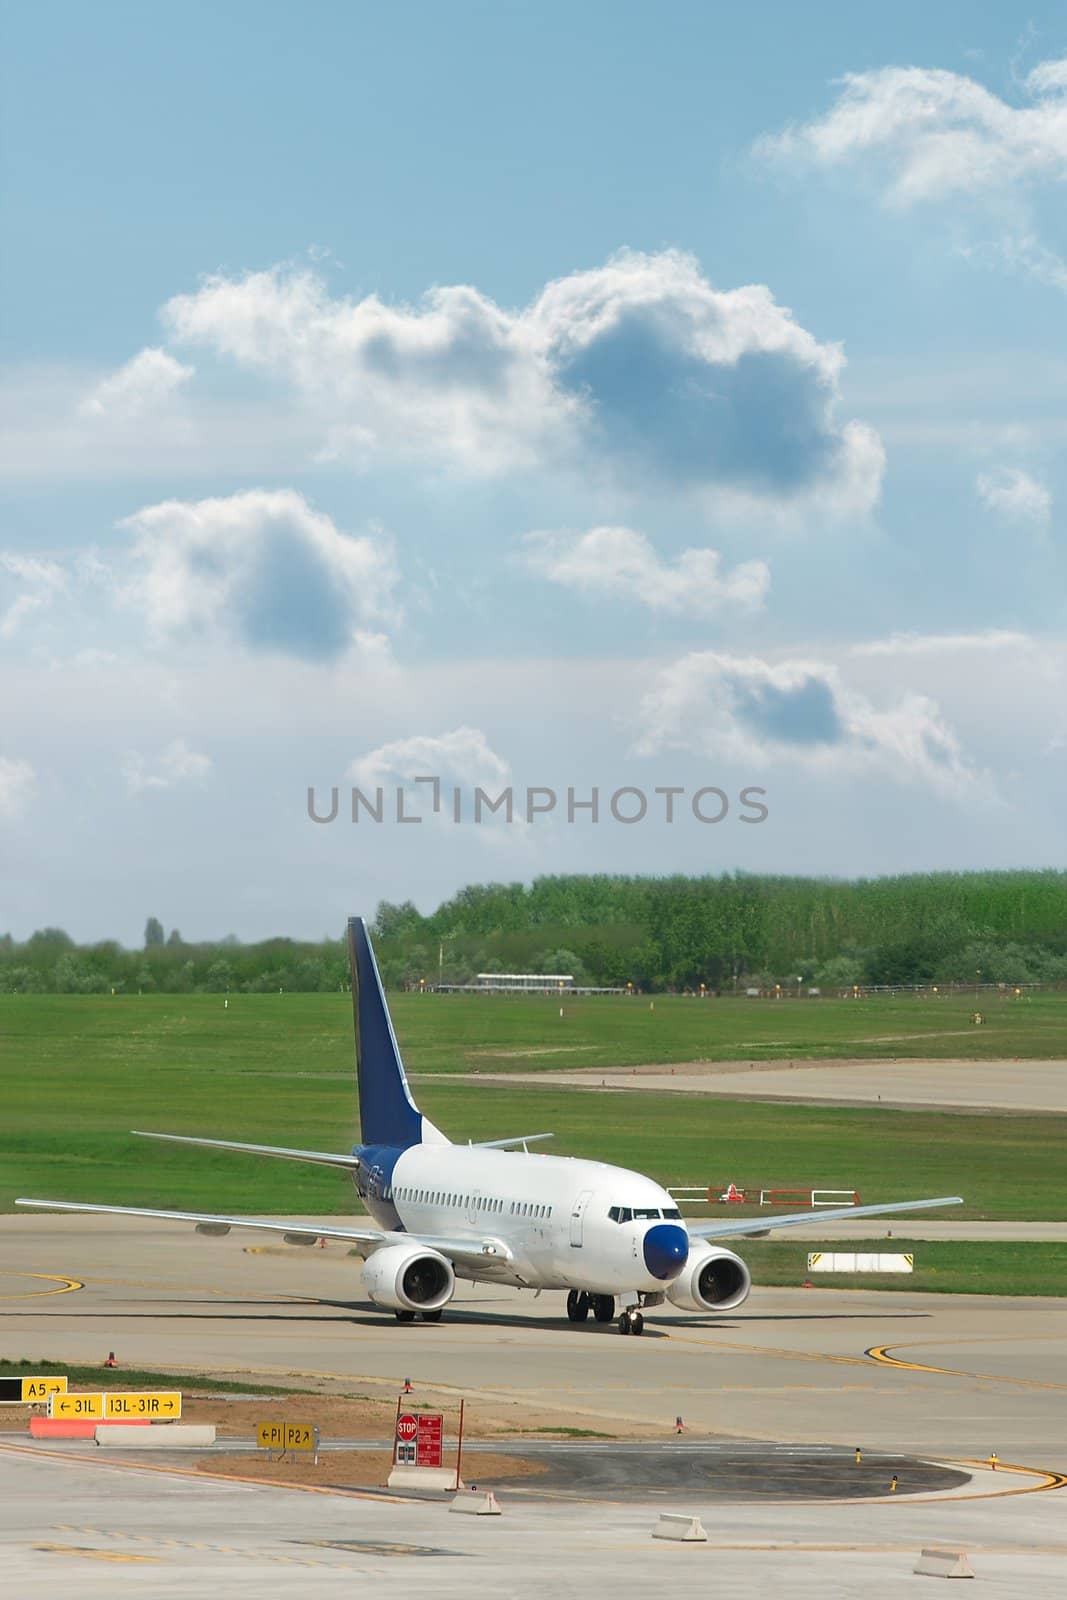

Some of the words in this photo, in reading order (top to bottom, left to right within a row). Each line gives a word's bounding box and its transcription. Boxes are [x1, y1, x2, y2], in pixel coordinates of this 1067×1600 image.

[28, 1383, 46, 1397] A5
[74, 1400, 95, 1412] 31L
[110, 1399, 159, 1412] 13L-31R
[398, 1422, 417, 1433] STOP
[272, 1428, 281, 1442] P1
[288, 1430, 301, 1443] P2
